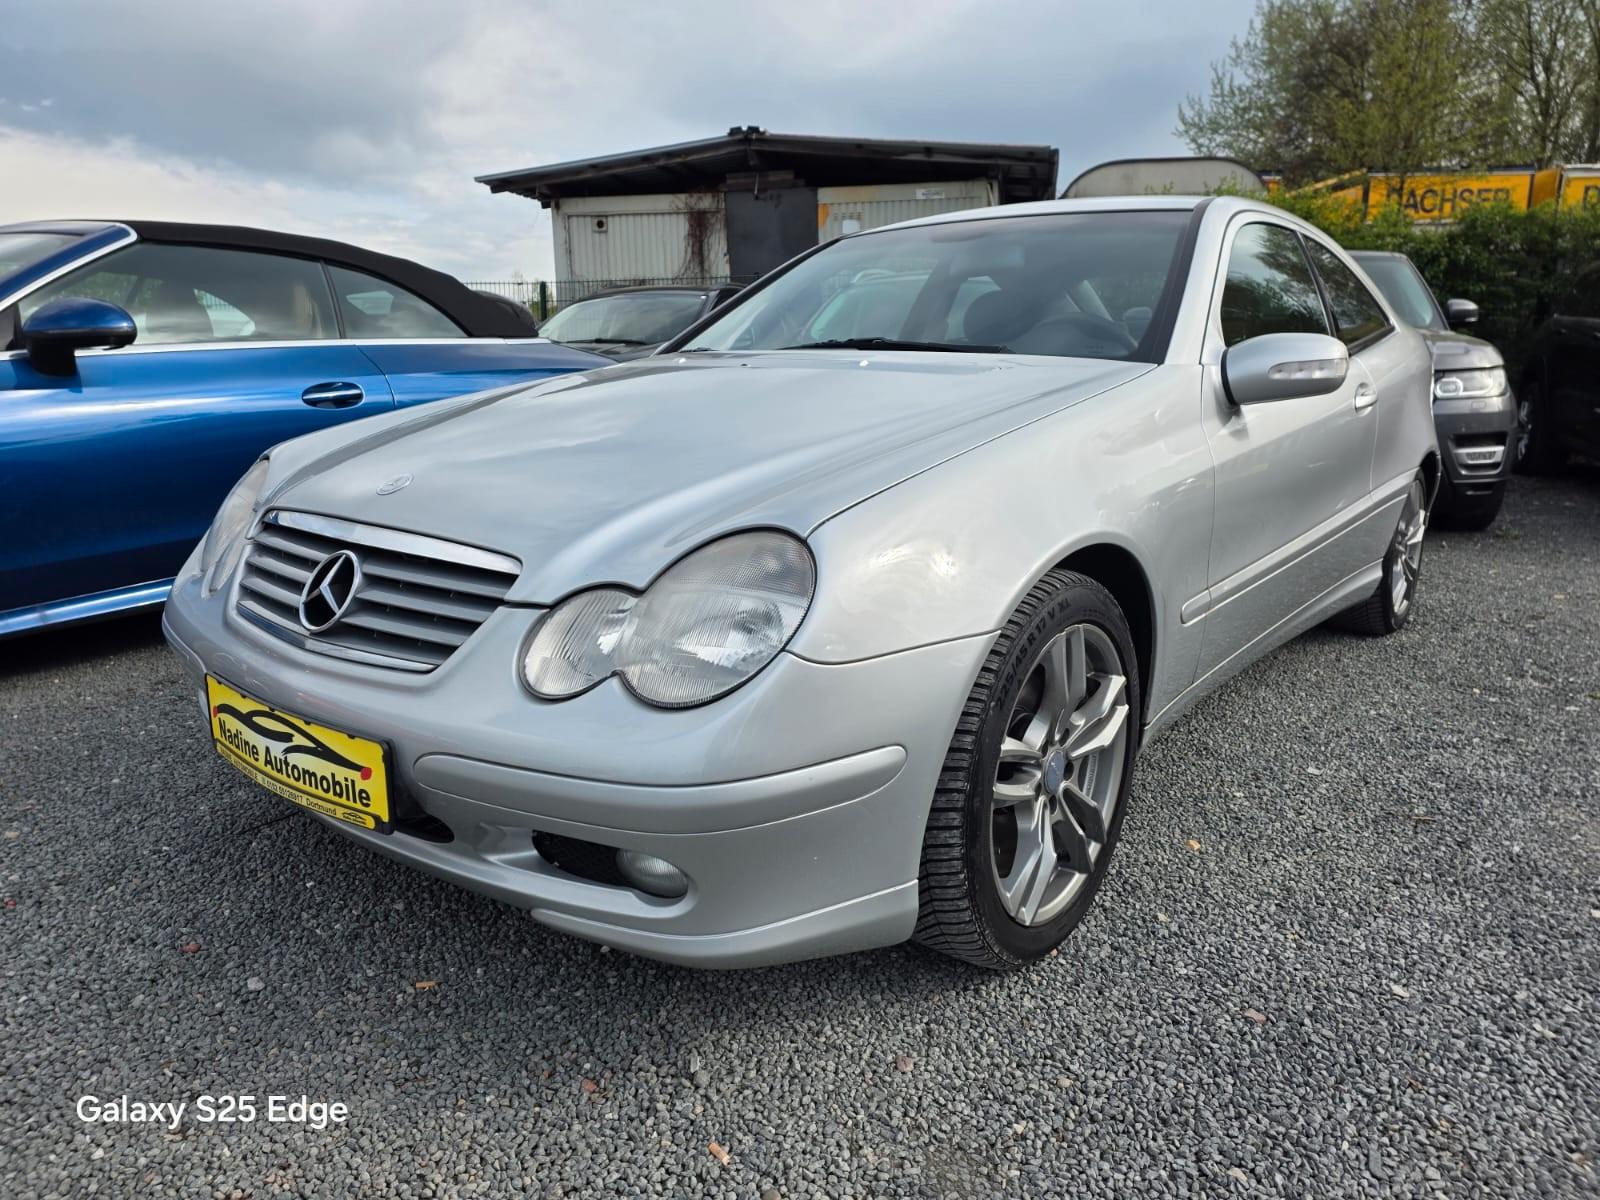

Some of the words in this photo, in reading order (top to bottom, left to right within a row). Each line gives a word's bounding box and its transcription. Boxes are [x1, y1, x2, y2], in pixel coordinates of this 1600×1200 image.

[1026, 632, 1036, 646] R
[1035, 616, 1046, 634] 17
[1047, 606, 1056, 619] V
[218, 717, 259, 761] Nadine
[264, 746, 371, 808] Automobile
[306, 797, 337, 816] Dortmund
